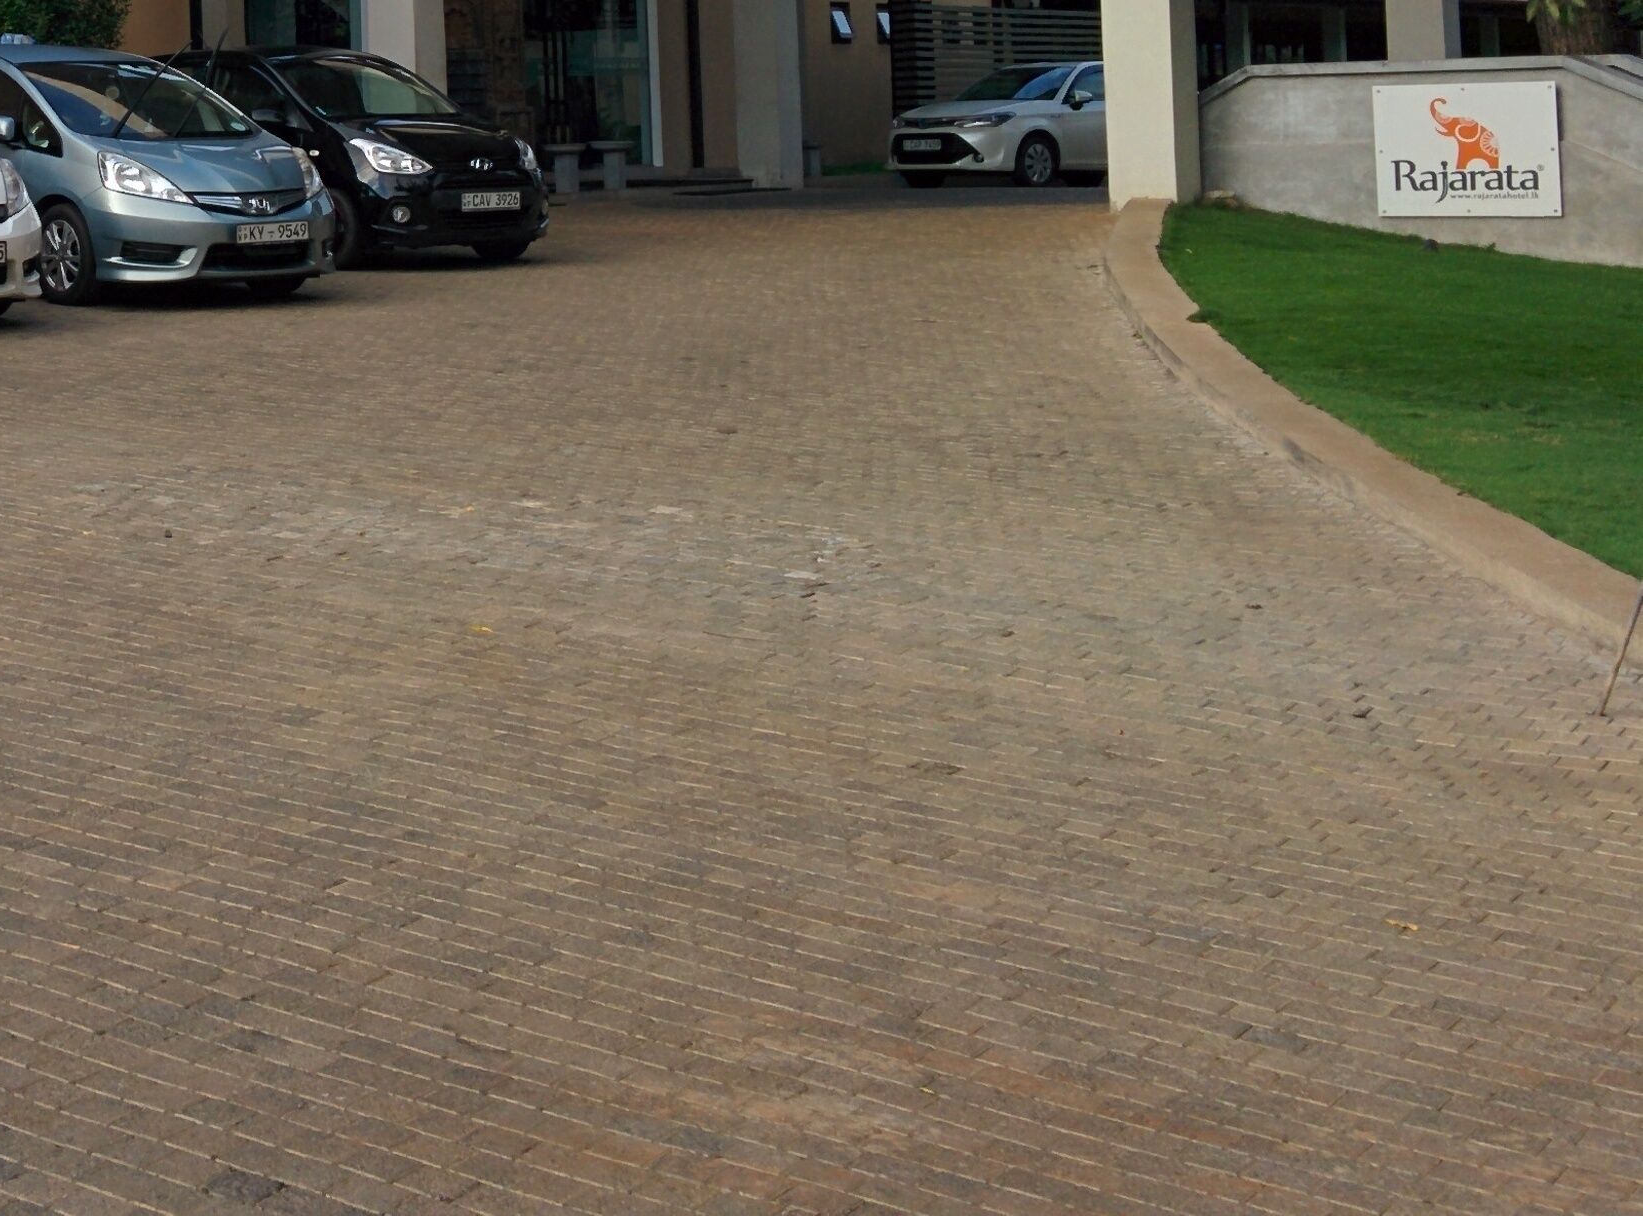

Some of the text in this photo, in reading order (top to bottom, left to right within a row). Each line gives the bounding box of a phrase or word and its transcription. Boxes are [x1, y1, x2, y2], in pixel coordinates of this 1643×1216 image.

[1391, 159, 1540, 204] Rajarata
[472, 194, 491, 207] CAV
[495, 193, 519, 206] 3926
[249, 225, 265, 241] KY
[278, 222, 307, 239] 9549
